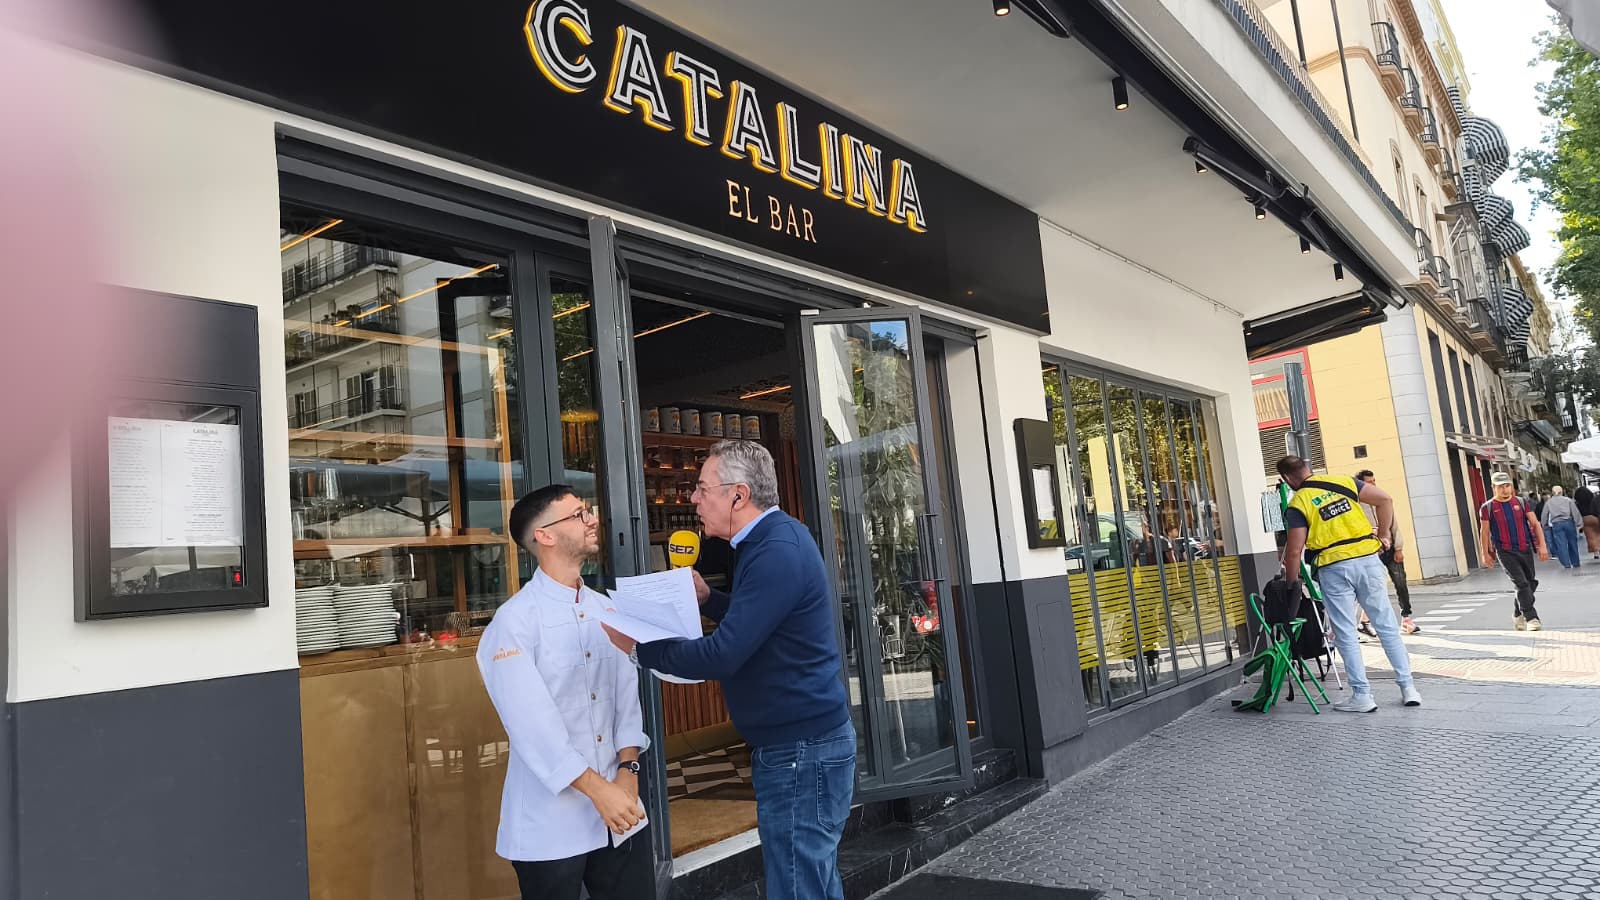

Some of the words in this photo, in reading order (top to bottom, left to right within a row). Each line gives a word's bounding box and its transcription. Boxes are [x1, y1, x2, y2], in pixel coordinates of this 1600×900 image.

[523, 0, 927, 232] CATALINA
[727, 179, 759, 223] EL
[767, 195, 817, 243] BAR
